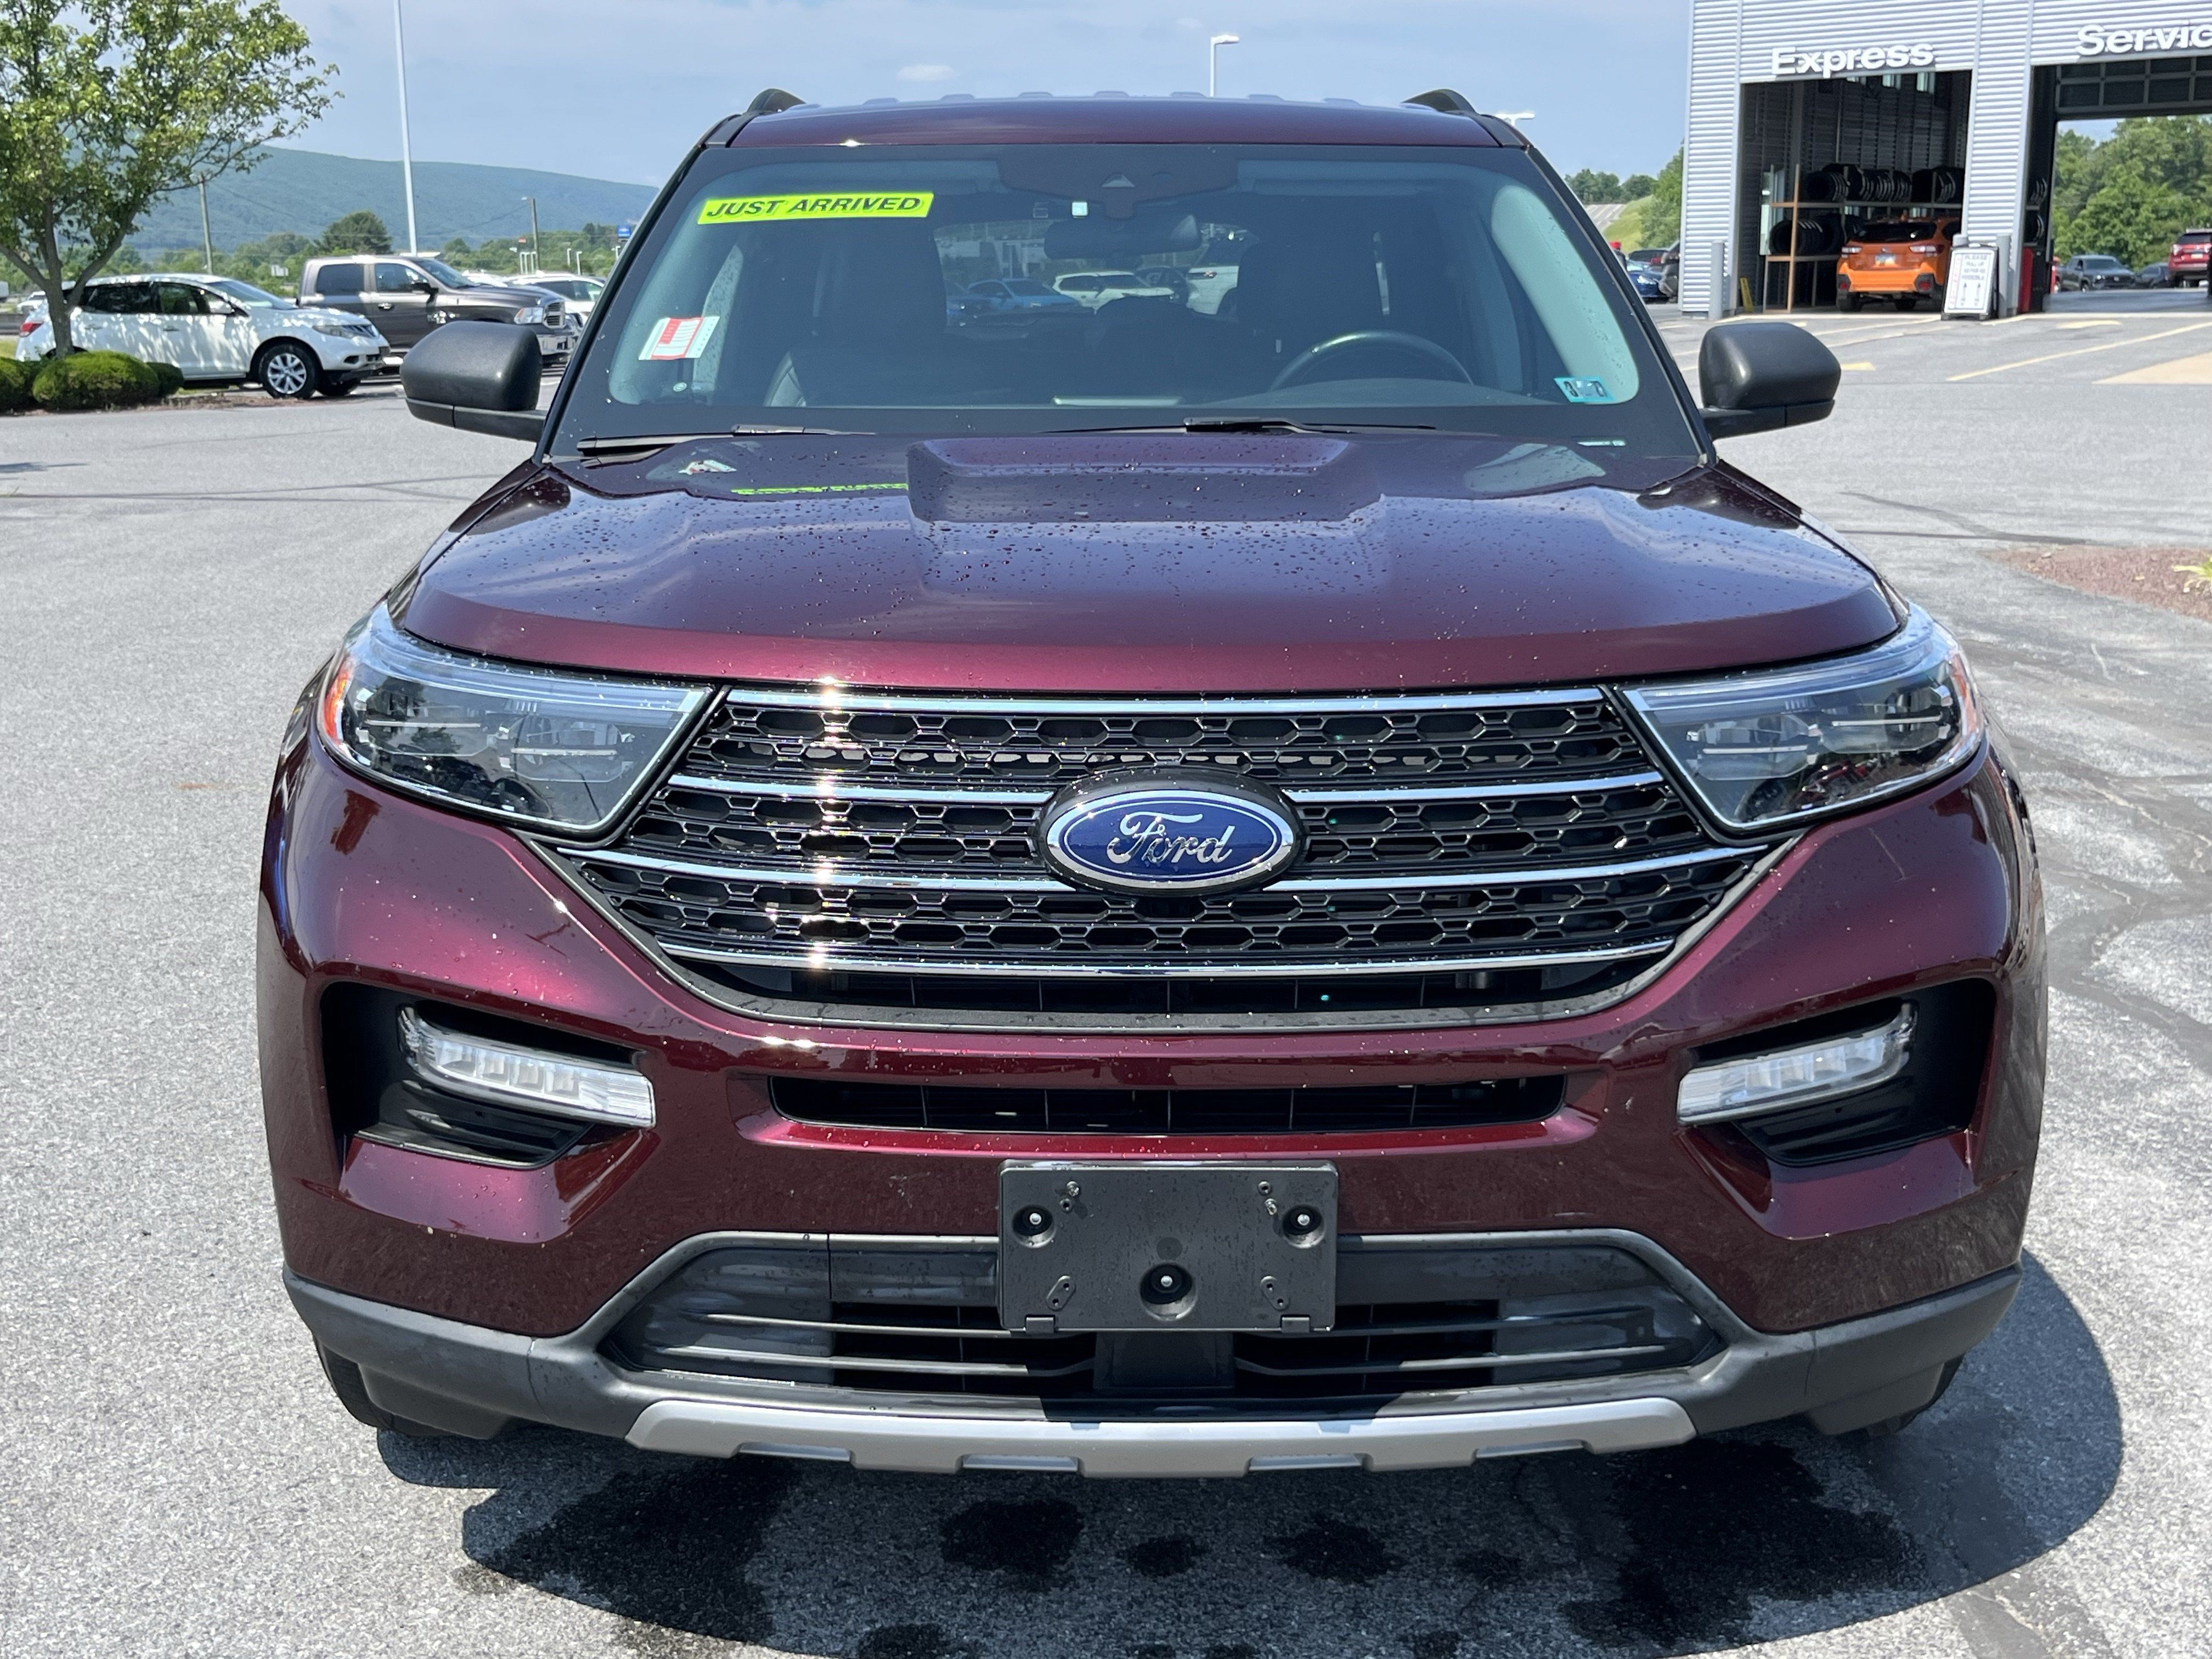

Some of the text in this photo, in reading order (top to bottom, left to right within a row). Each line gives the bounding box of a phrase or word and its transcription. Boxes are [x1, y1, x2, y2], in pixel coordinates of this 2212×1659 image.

[1772, 43, 1934, 78] Express
[707, 197, 921, 217] JUST ARRIVED
[1107, 811, 1235, 865] Ford
